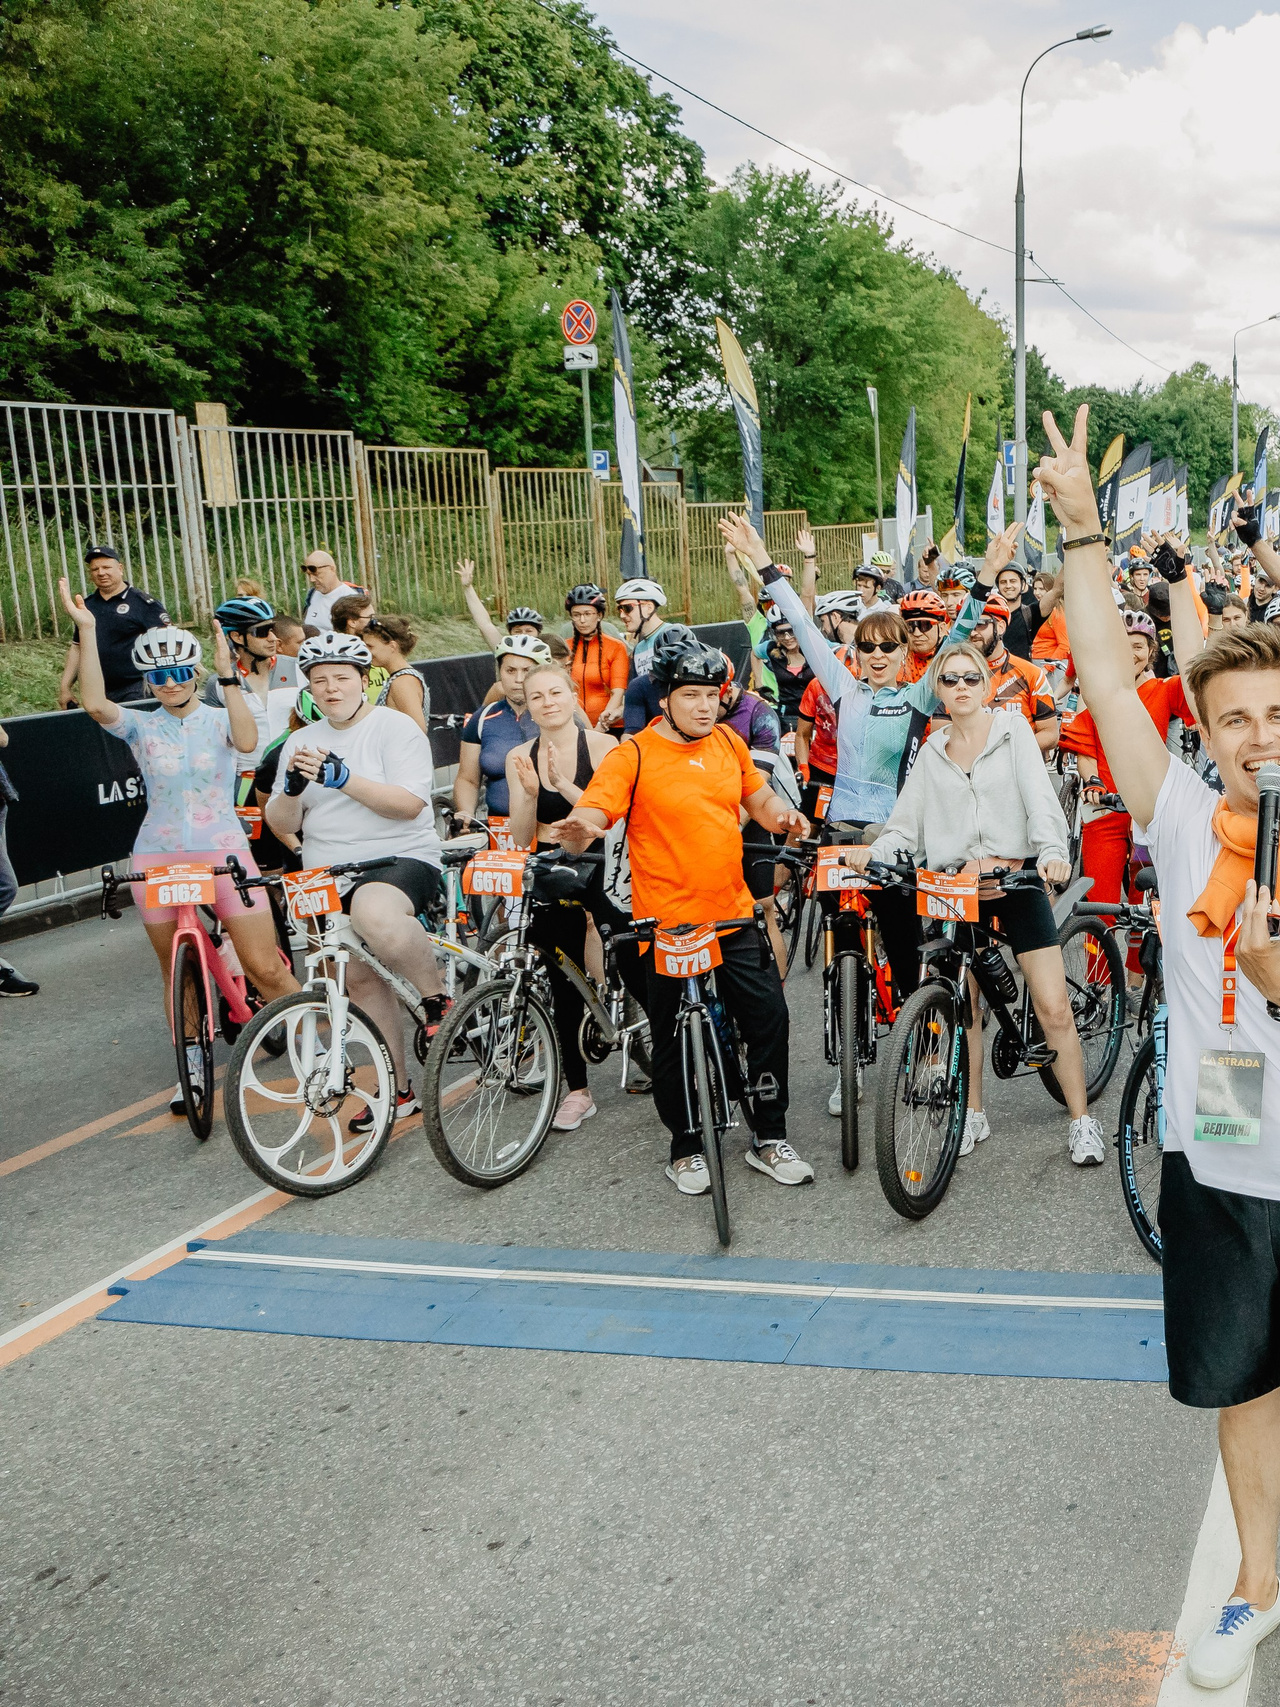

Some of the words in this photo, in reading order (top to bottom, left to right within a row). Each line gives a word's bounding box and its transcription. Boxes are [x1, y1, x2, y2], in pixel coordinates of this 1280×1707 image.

[592, 452, 605, 470] P
[1103, 483, 1112, 513] STRADA
[98, 780, 125, 804] LA
[158, 883, 203, 905] 6162
[472, 870, 513, 894] 6679
[926, 894, 966, 919] 6014
[665, 947, 712, 975] 6779
[1201, 1055, 1216, 1065] LA
[1217, 1056, 1261, 1068] STRADA
[1202, 1121, 1253, 1138] ВЕДУЩИЙ
